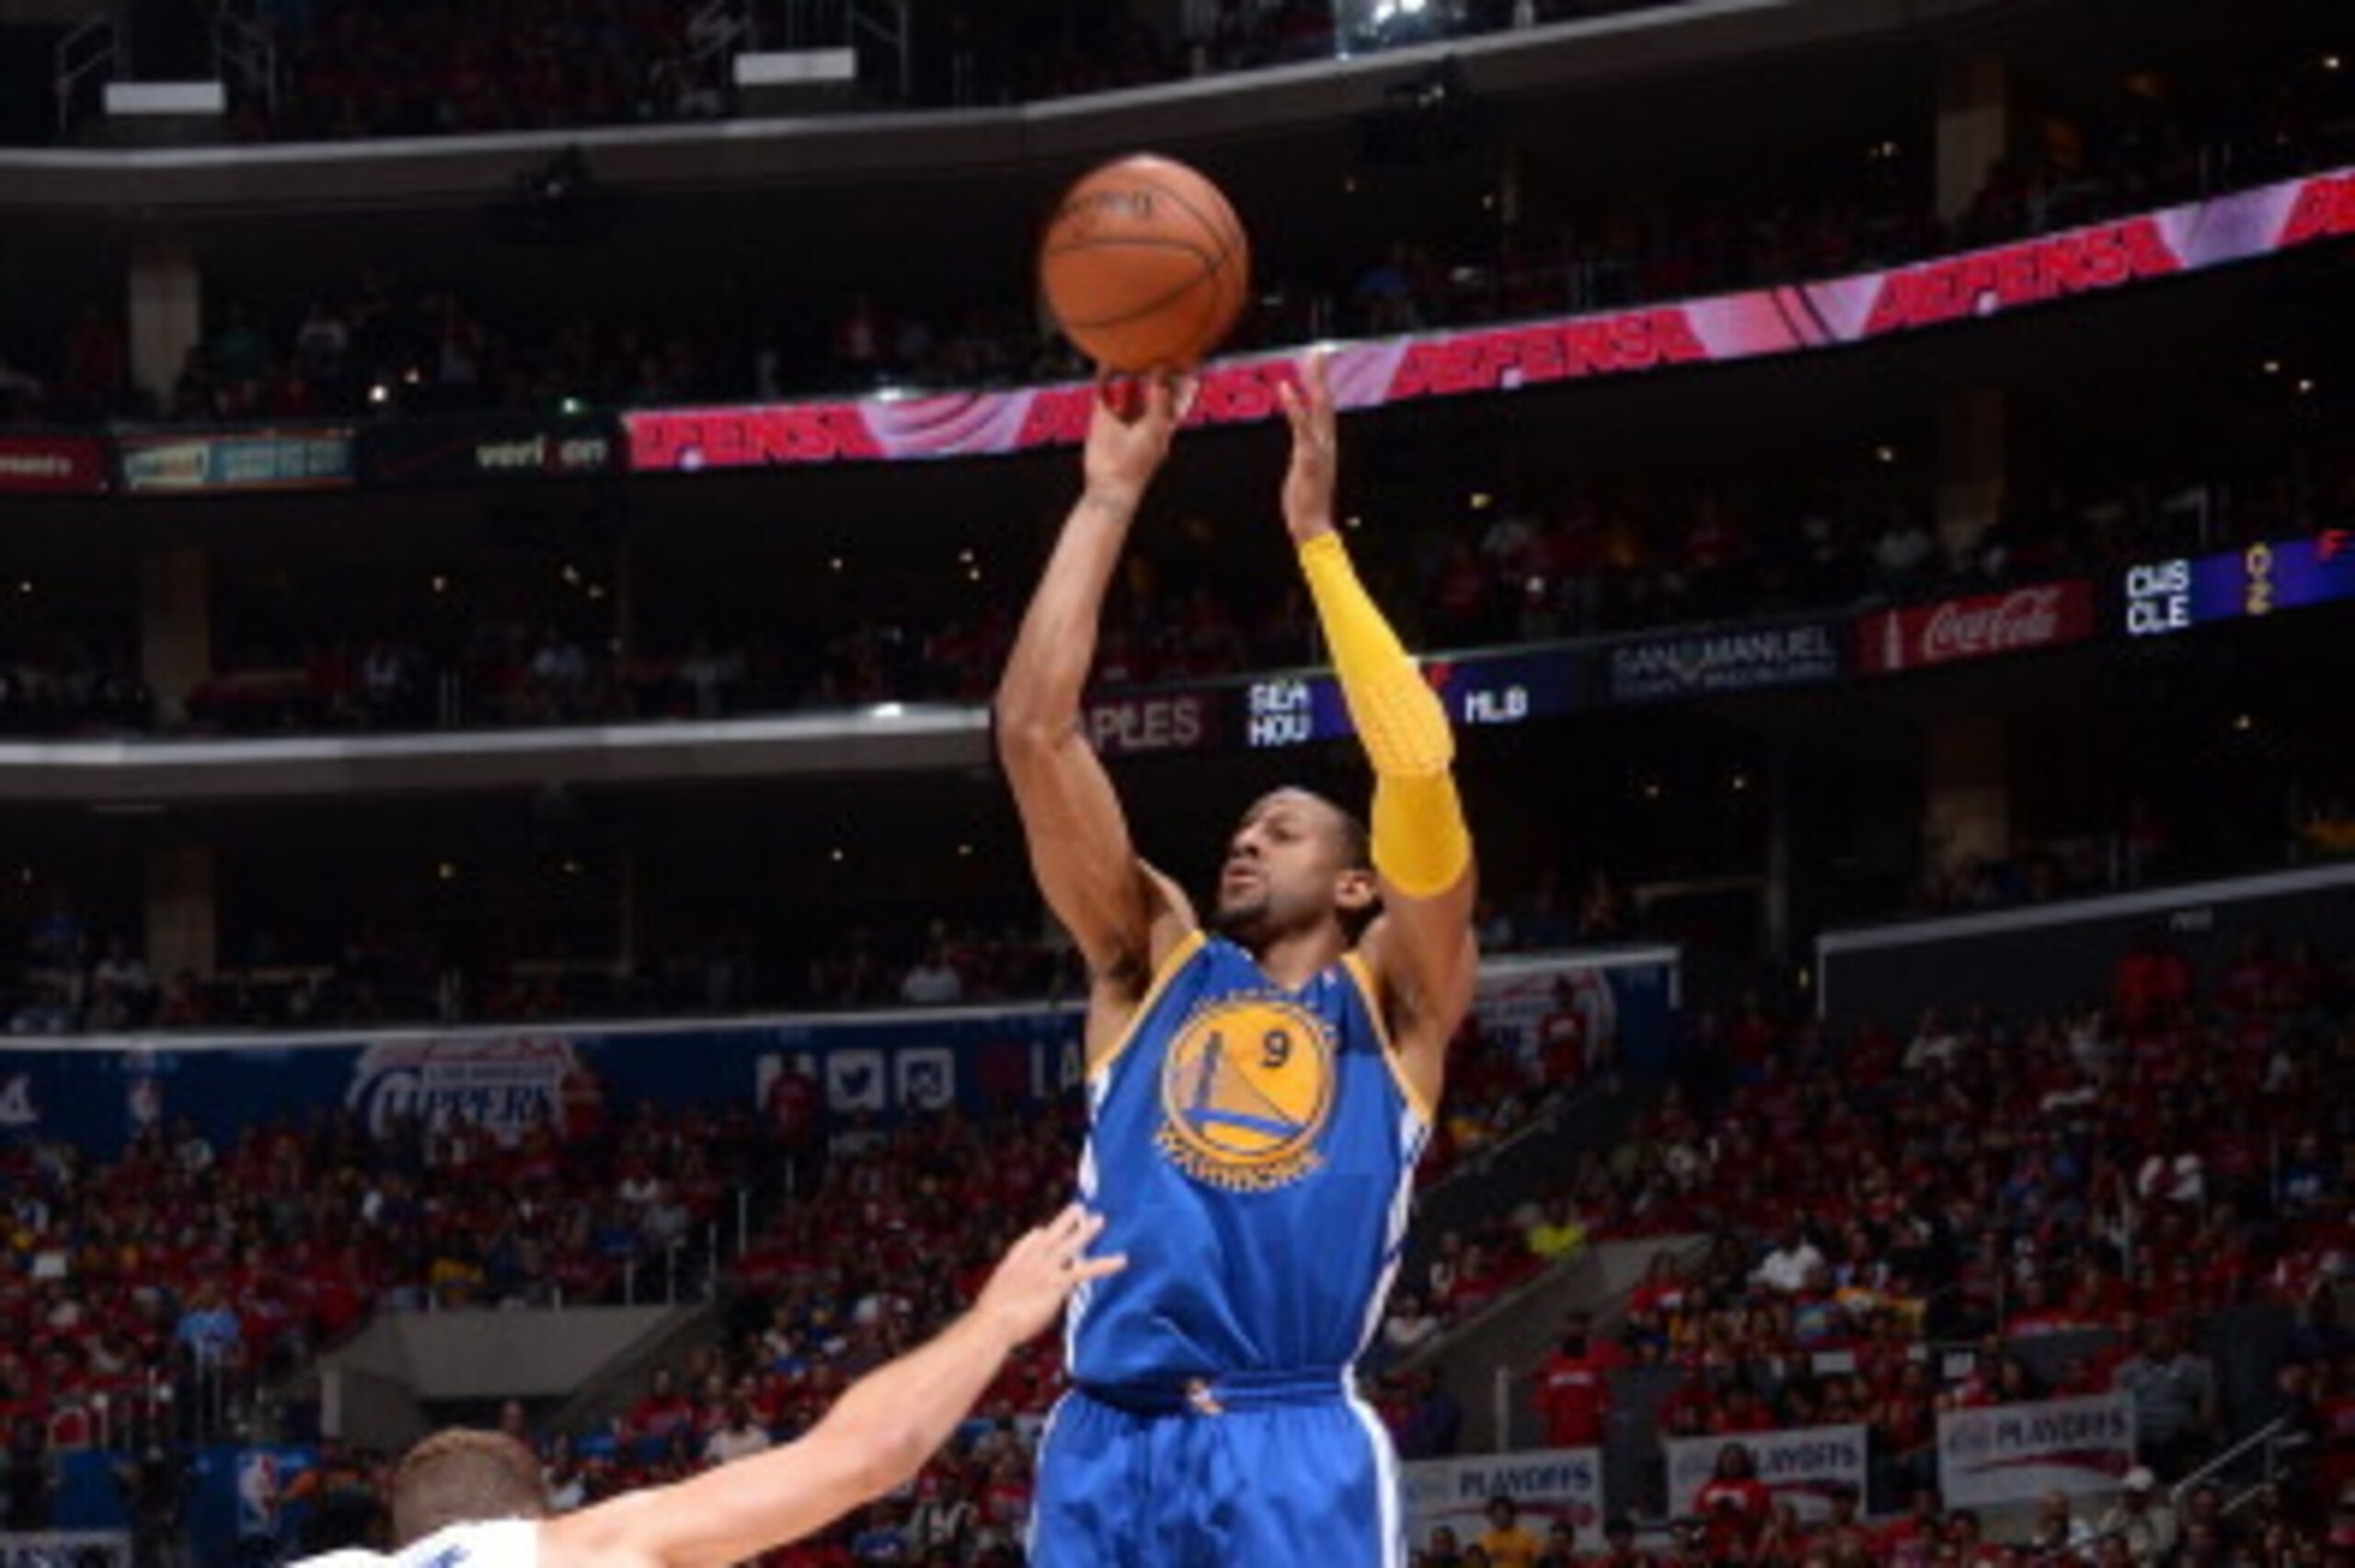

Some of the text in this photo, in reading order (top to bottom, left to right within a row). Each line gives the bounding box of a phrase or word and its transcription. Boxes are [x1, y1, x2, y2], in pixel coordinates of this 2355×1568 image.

[2126, 558, 2190, 600] CWS
[2126, 593, 2191, 635] CLE
[1702, 624, 1831, 664] MANUEL
[1248, 677, 1309, 715] SEA
[1465, 686, 1528, 724] MLB
[1089, 697, 1200, 756] PLES
[1249, 711, 1311, 749] HOU
[1260, 1030, 1292, 1069] 9
[1997, 1408, 2126, 1449] PLAYOFFS
[1459, 1460, 1591, 1499] PLAYOFFS
